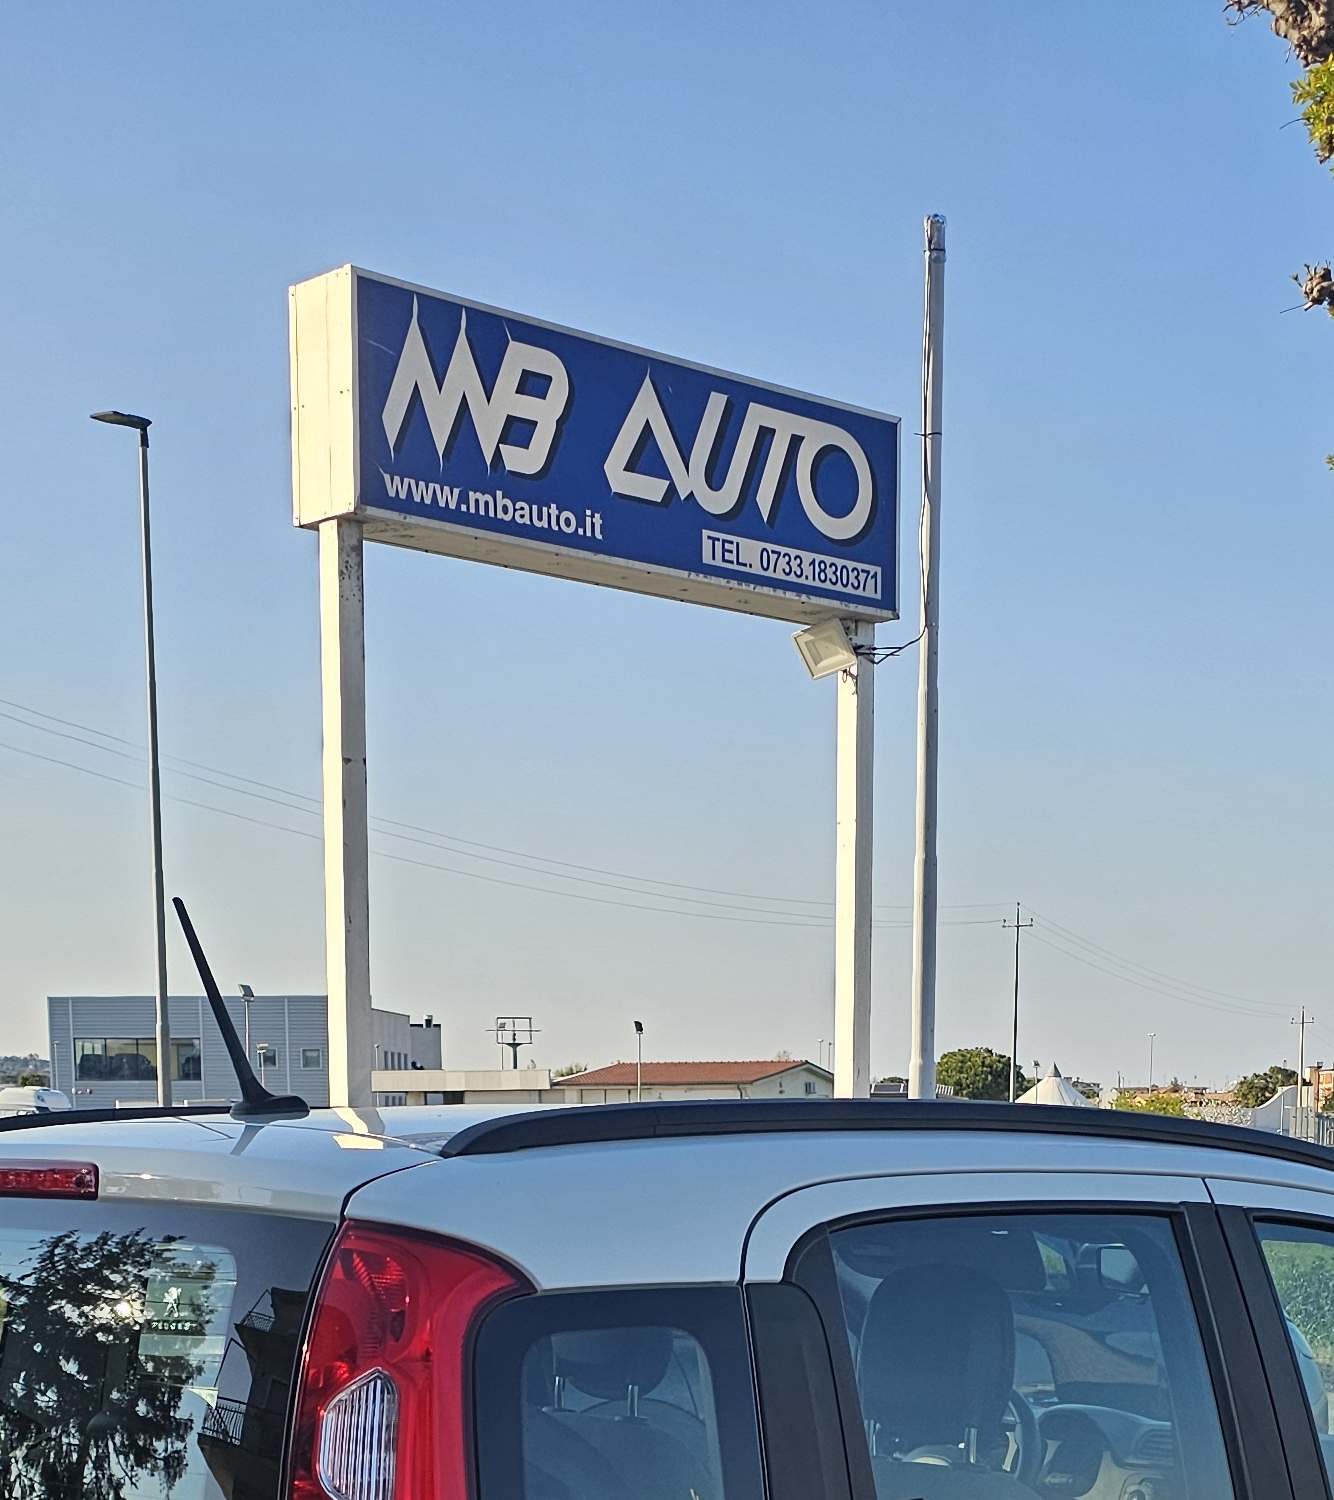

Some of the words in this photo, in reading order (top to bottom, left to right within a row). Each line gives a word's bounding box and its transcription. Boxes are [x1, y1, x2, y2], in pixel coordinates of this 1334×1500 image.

[381, 294, 570, 477] MB
[603, 368, 874, 541] AUTO
[383, 472, 604, 541] www.mbauto.it
[706, 534, 754, 572] TEL.
[759, 544, 881, 598] 0733.1830371
